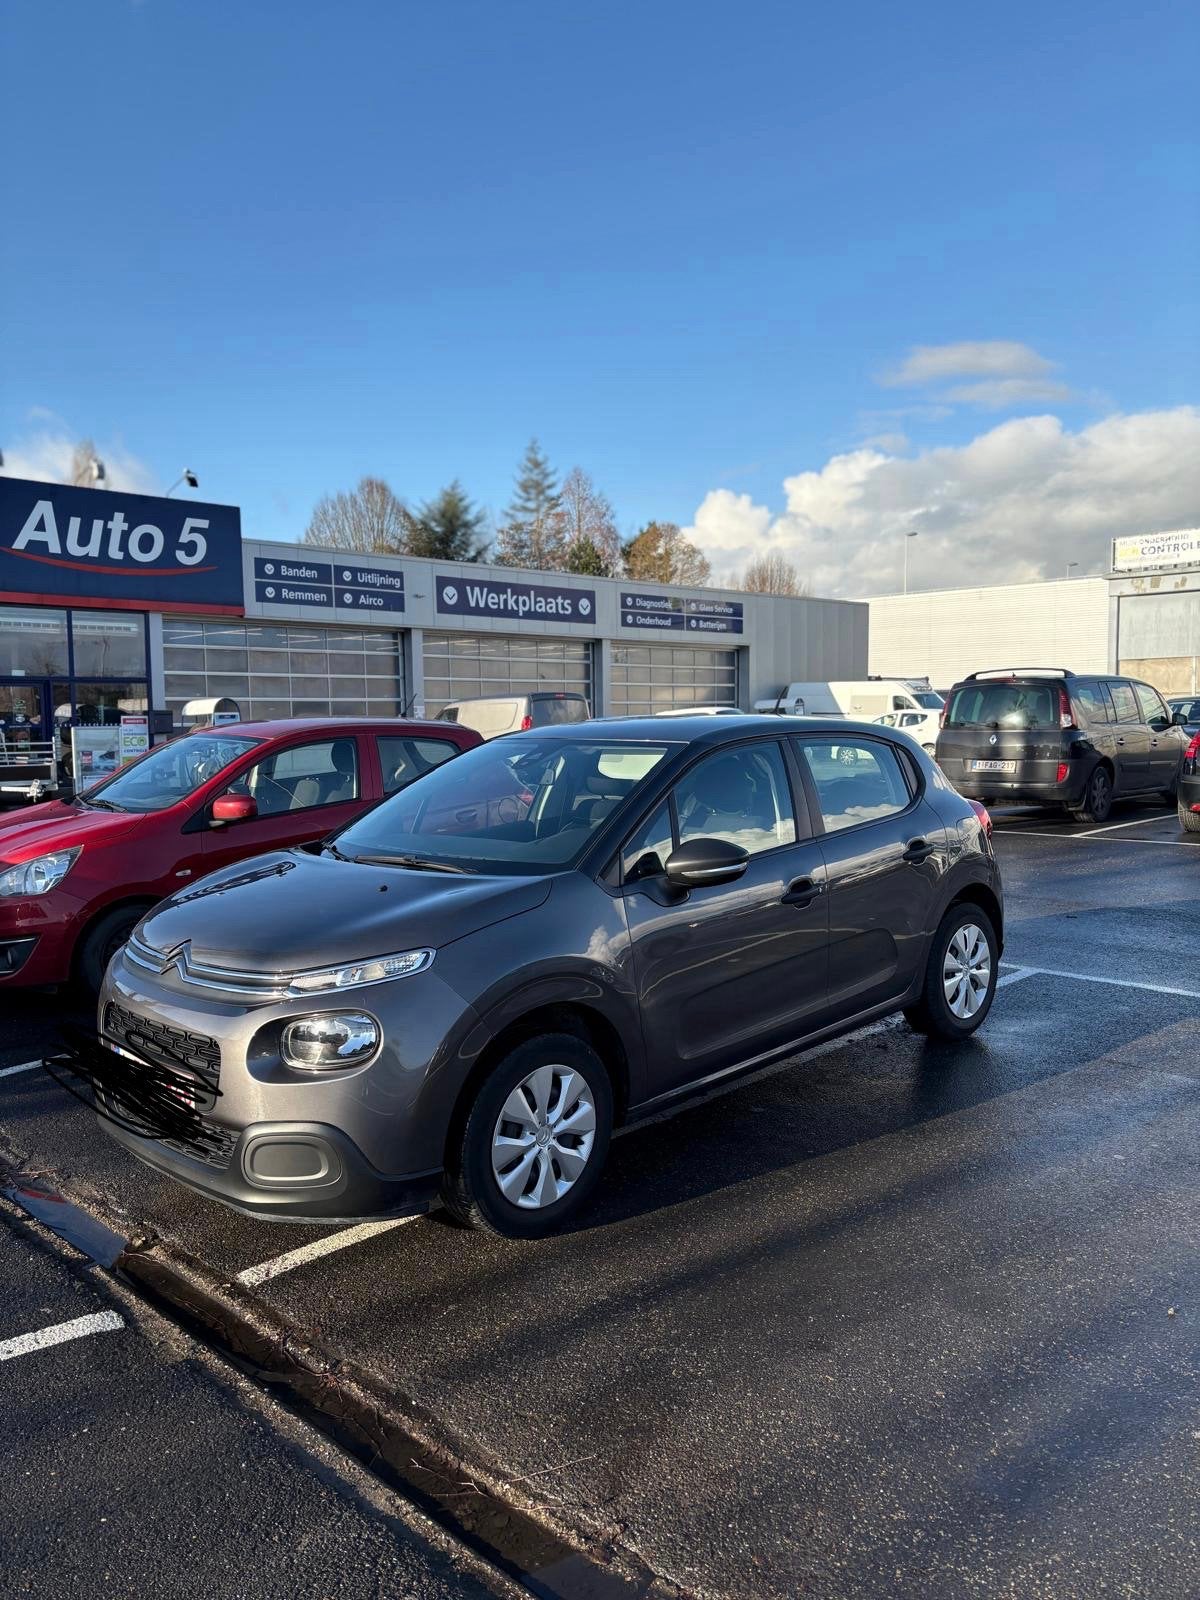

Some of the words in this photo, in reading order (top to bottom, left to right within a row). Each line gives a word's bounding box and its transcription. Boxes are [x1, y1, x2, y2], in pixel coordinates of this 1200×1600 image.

[12, 499, 164, 563] Auto
[175, 517, 210, 566] 5
[281, 565, 318, 579] Banden
[357, 572, 401, 589] Uitlijning
[281, 588, 327, 602] Remmen
[358, 594, 384, 606] Airco
[465, 585, 572, 616] Werkplaats
[635, 598, 673, 610] Diagnostiek
[714, 605, 734, 614] Service
[636, 616, 672, 626] Onderhoud
[699, 620, 727, 631] Batterijen
[123, 736, 147, 747] ECO
